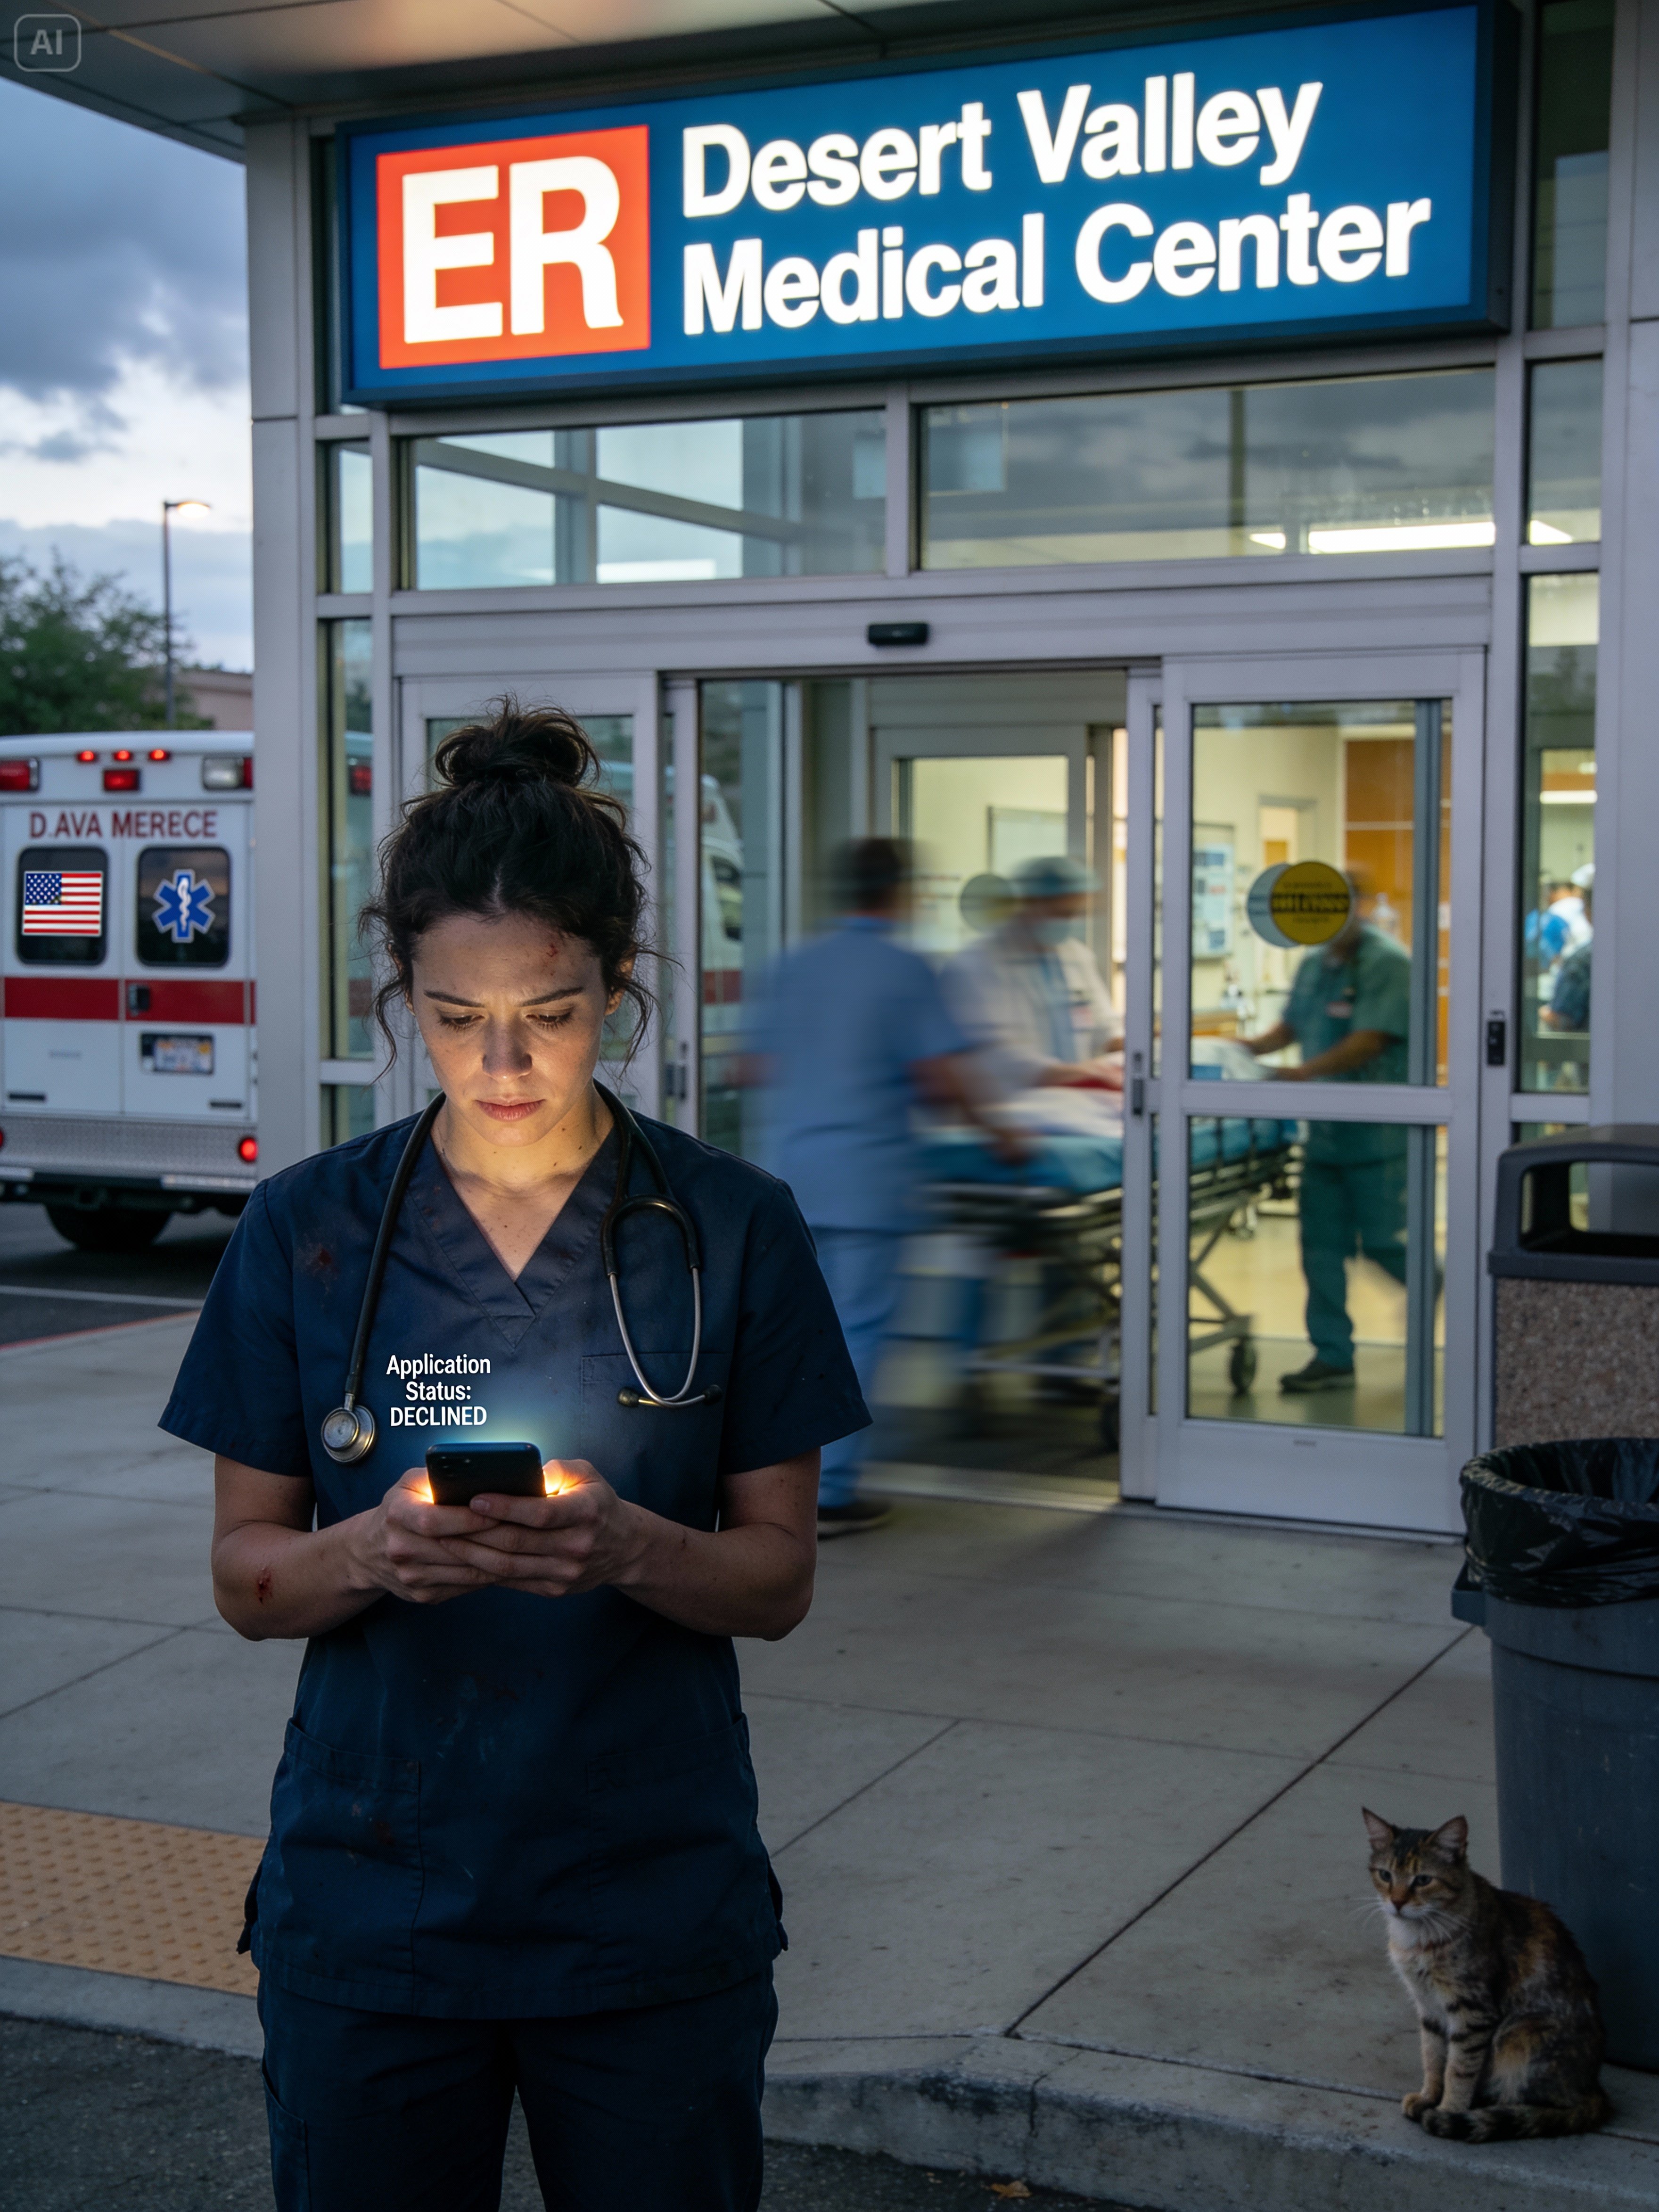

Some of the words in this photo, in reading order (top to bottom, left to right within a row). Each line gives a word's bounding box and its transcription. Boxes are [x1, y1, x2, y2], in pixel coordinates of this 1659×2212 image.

[682, 101, 993, 218] Desert
[1016, 71, 1324, 187] Valley
[402, 156, 624, 344] ER
[682, 212, 1045, 336] Medical
[1074, 192, 1432, 304] Center
[111, 810, 218, 838] MERECE
